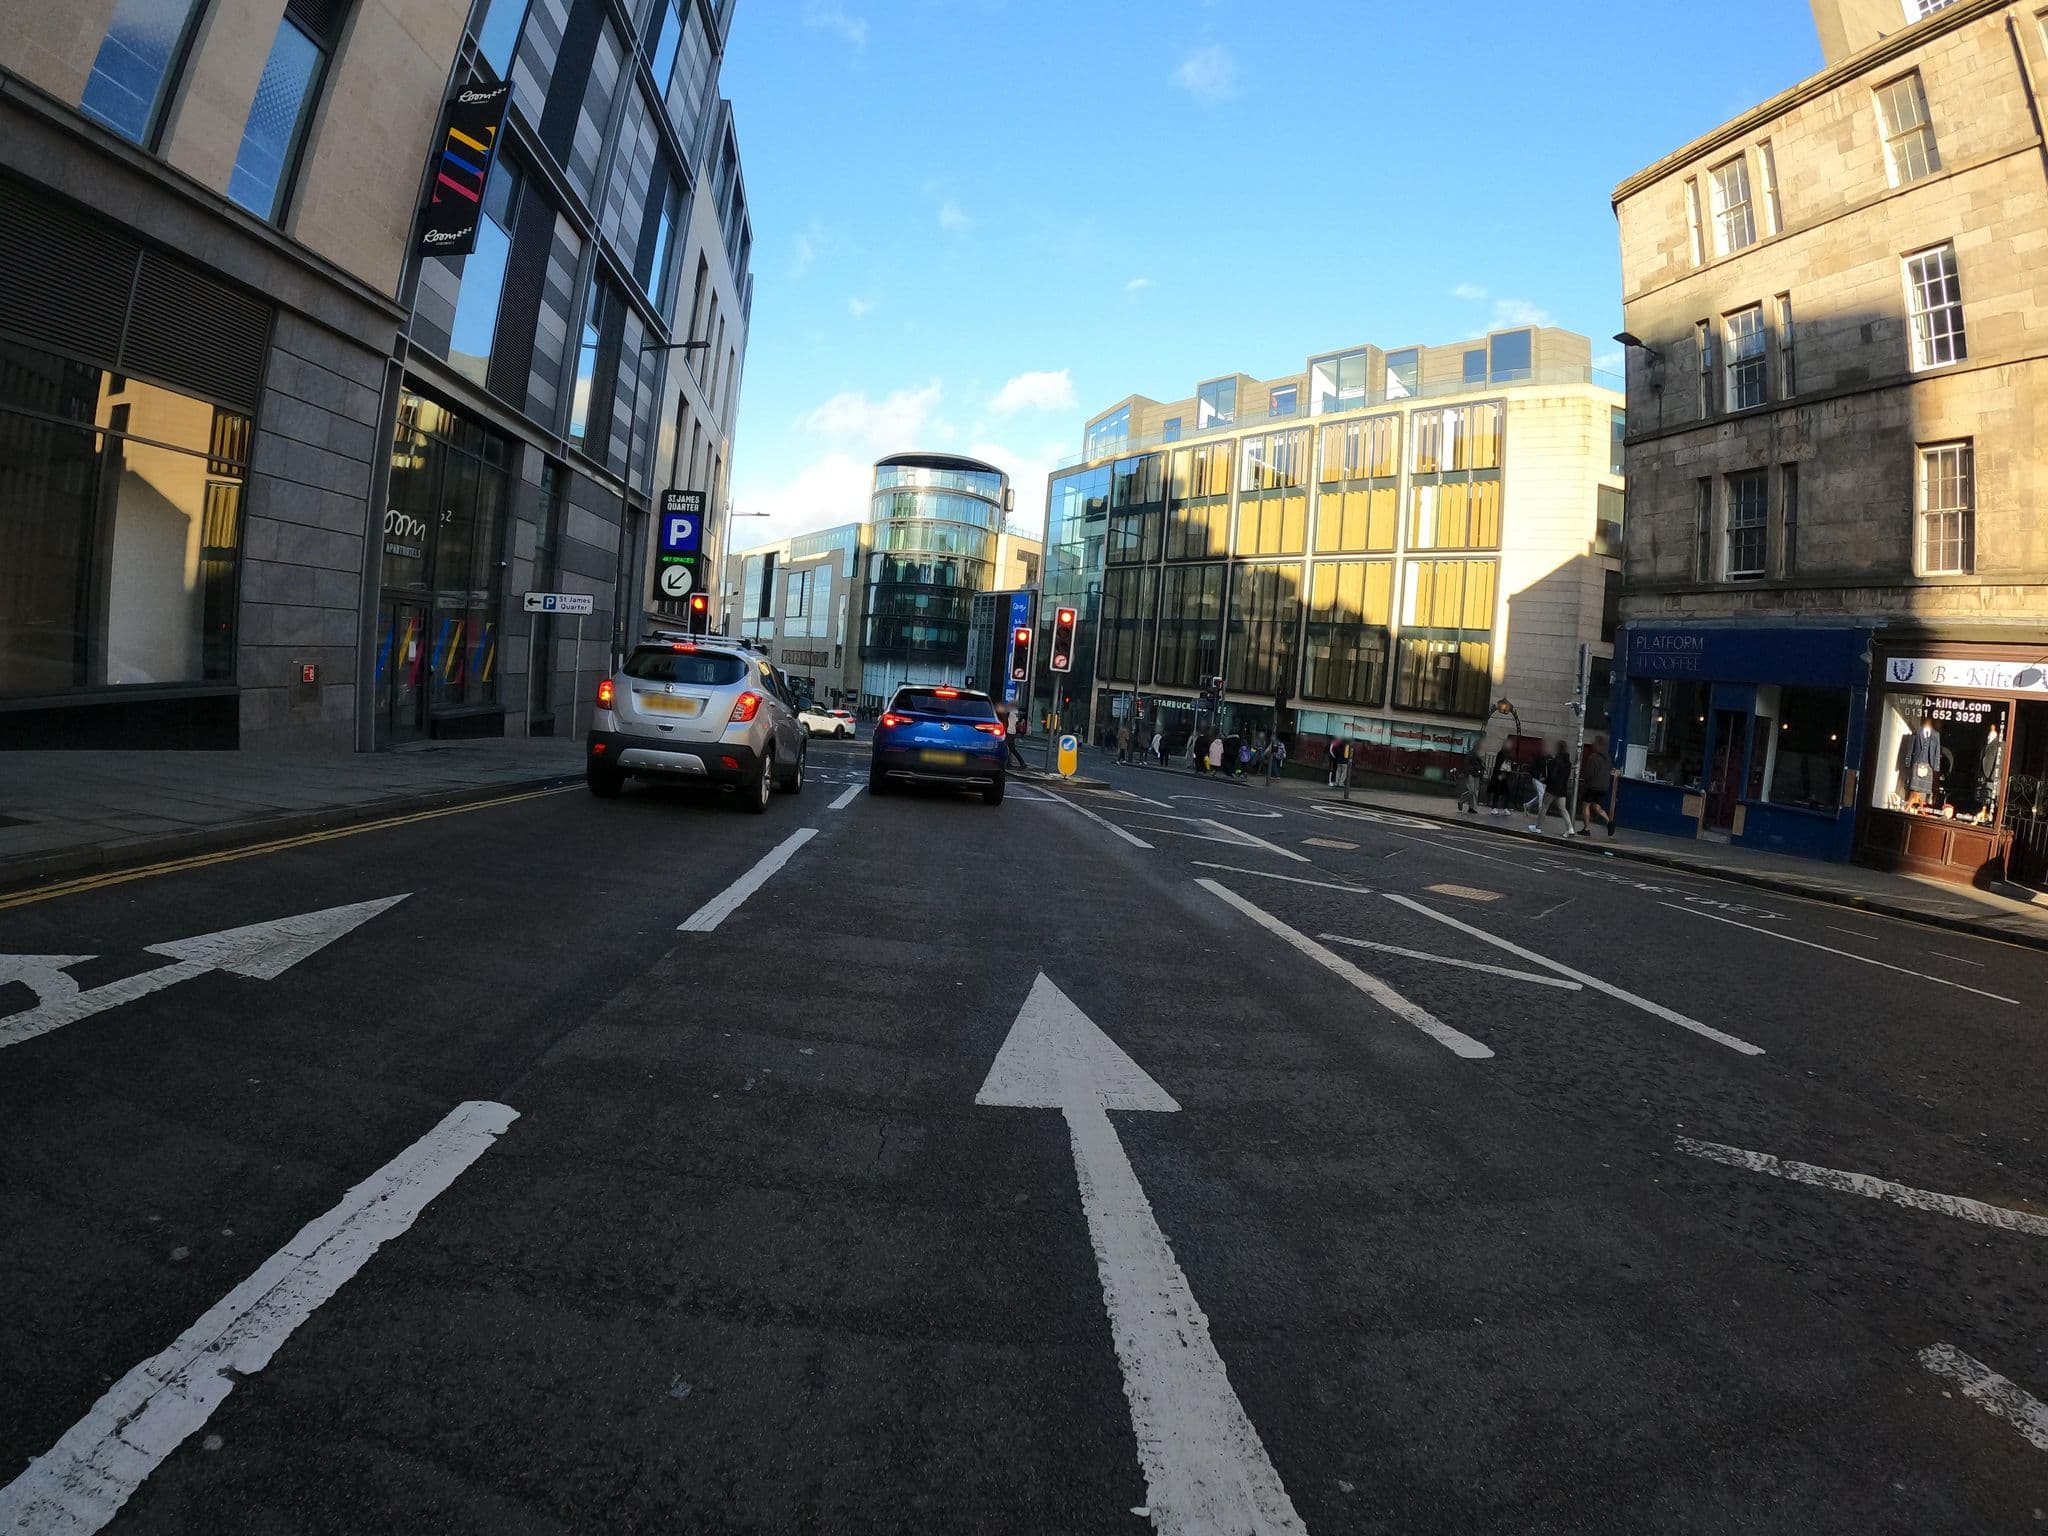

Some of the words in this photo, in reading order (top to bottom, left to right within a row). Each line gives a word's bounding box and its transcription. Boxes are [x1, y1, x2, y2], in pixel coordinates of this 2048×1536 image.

[676, 495, 700, 504] JAMES
[667, 502, 699, 512] QUARTER
[669, 518, 692, 546] P
[569, 596, 591, 604] James
[560, 603, 588, 611] Quarter
[1636, 635, 1704, 650] PLATFORM
[1931, 665, 1946, 684] B
[1153, 699, 1195, 711] STARBUCK
[1898, 697, 1992, 713] www.b-kilted.com
[1904, 707, 1928, 718] 0131
[1932, 709, 1952, 721] 652
[1955, 711, 1983, 724] 3928
